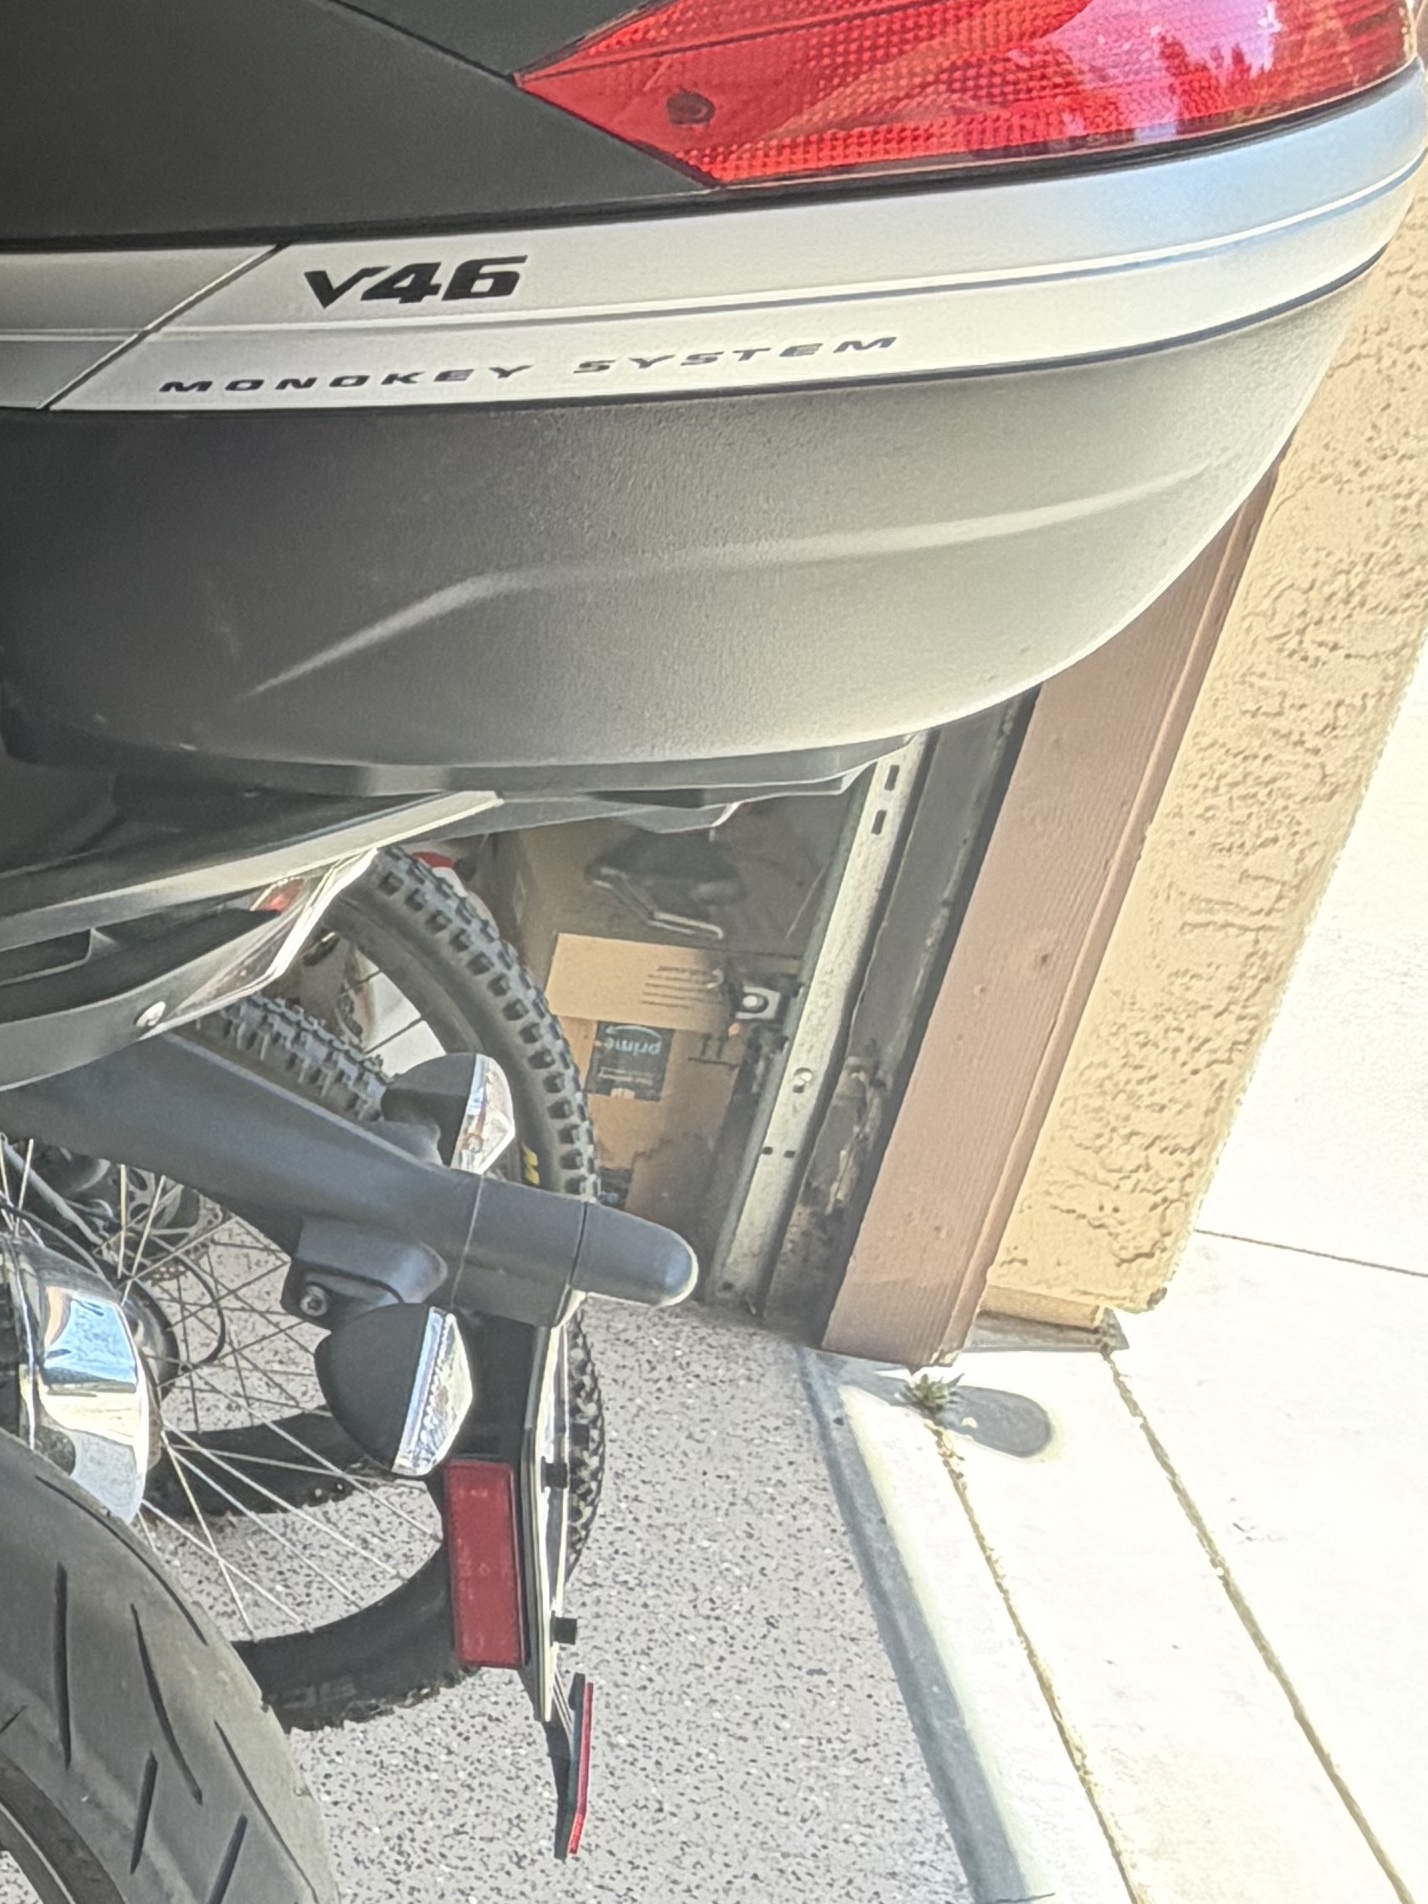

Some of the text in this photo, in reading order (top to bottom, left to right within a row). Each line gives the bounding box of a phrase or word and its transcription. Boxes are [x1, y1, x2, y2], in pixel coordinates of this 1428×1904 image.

[304, 254, 529, 309] V46
[158, 336, 899, 393] MONOKEY SYSTEM
[604, 1036, 663, 1056] prime
